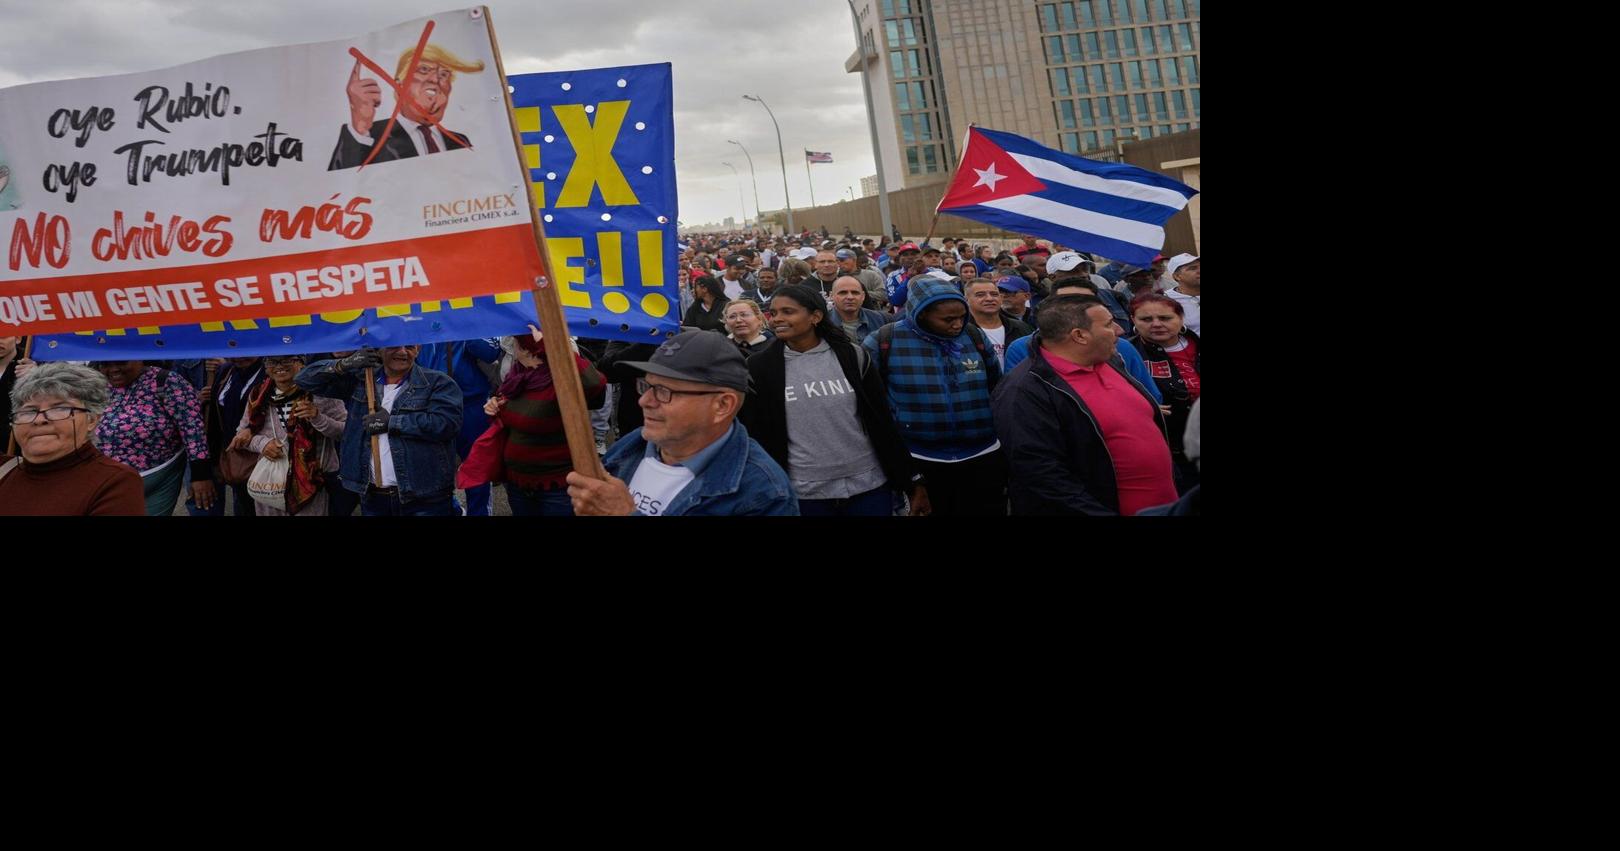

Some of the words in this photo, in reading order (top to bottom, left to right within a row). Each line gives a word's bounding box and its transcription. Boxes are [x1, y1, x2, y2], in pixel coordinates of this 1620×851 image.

[47, 105, 116, 148] oye
[133, 82, 242, 133] Rubio.
[42, 161, 97, 203] oye
[113, 122, 304, 187] Trumpeta
[9, 211, 72, 272] NO
[91, 209, 235, 262] chives
[258, 192, 374, 244] más
[422, 192, 517, 220] FINCIMEX
[424, 216, 469, 228] Financiera
[471, 209, 502, 222] CIMEX
[0, 294, 56, 326] QUE
[57, 290, 103, 320] MI
[105, 281, 212, 316] GENTE
[214, 275, 264, 308] SE
[270, 255, 431, 303] RESPETA
[629, 488, 663, 515] CES
